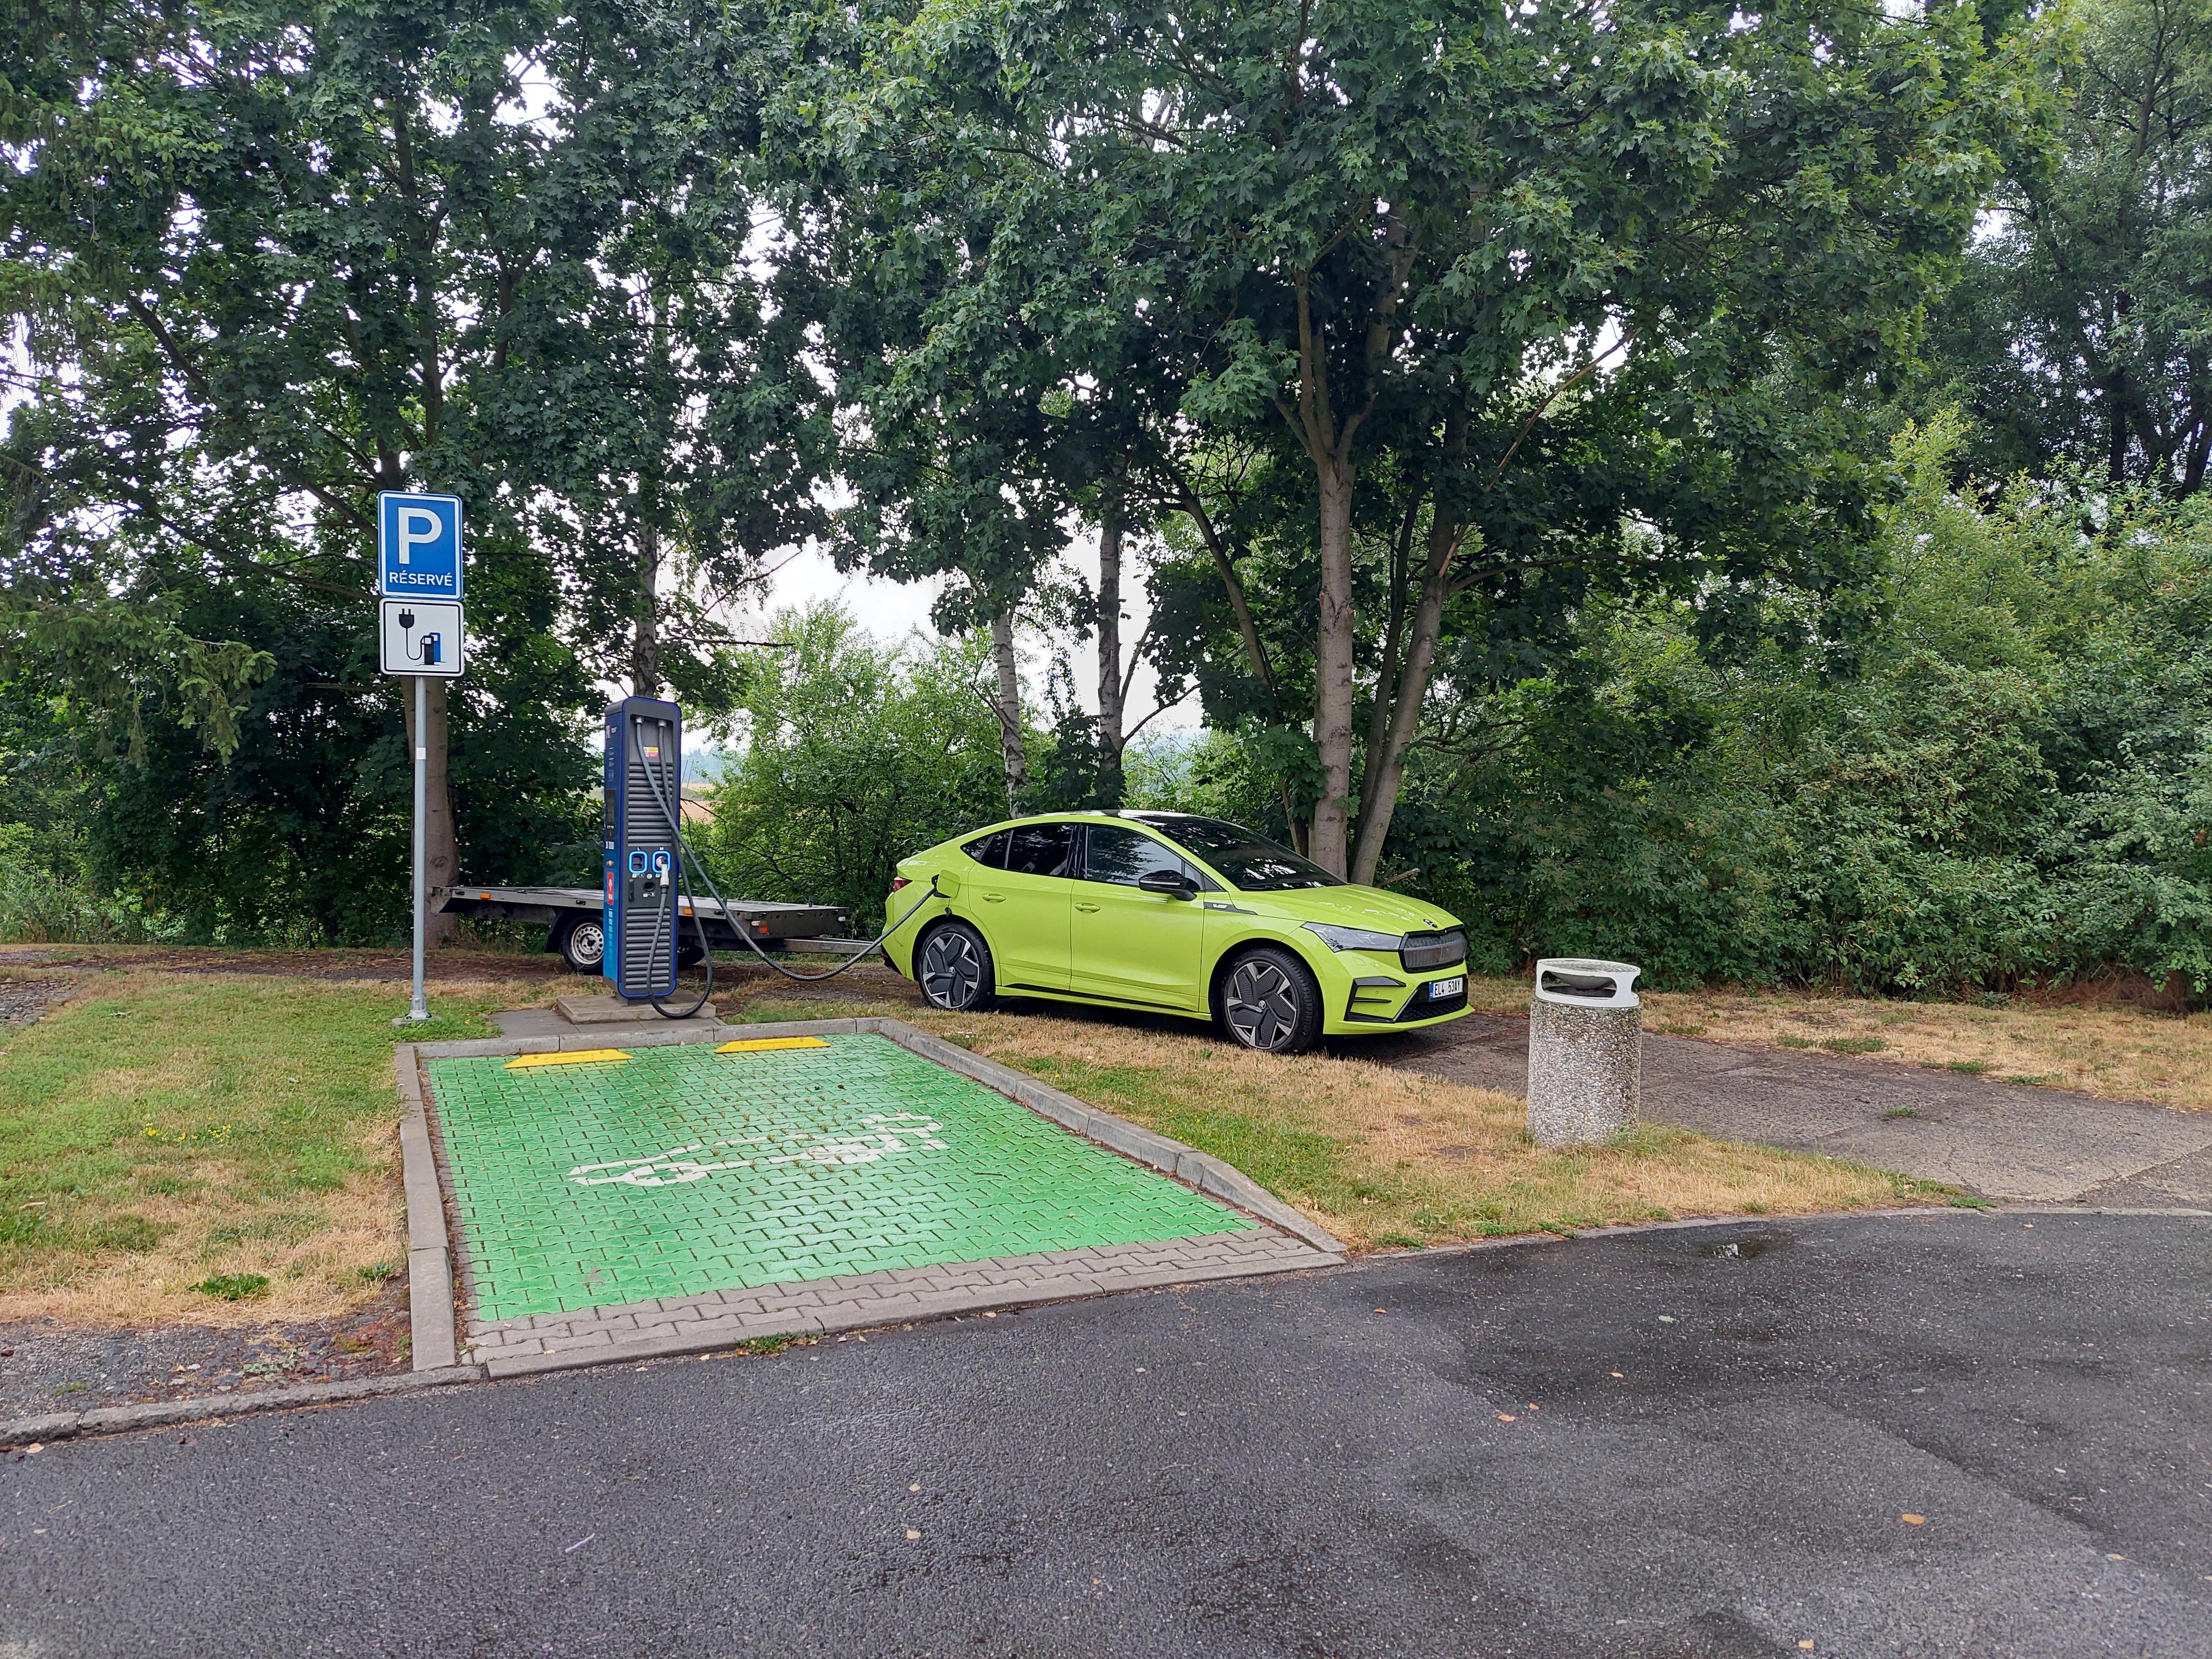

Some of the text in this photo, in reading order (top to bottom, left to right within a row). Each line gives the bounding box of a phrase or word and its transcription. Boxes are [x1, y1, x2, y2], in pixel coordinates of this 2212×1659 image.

[398, 507, 442, 564] P
[389, 570, 452, 586] RÉSERVÉ
[1434, 979, 1460, 996] EL4 53AY
